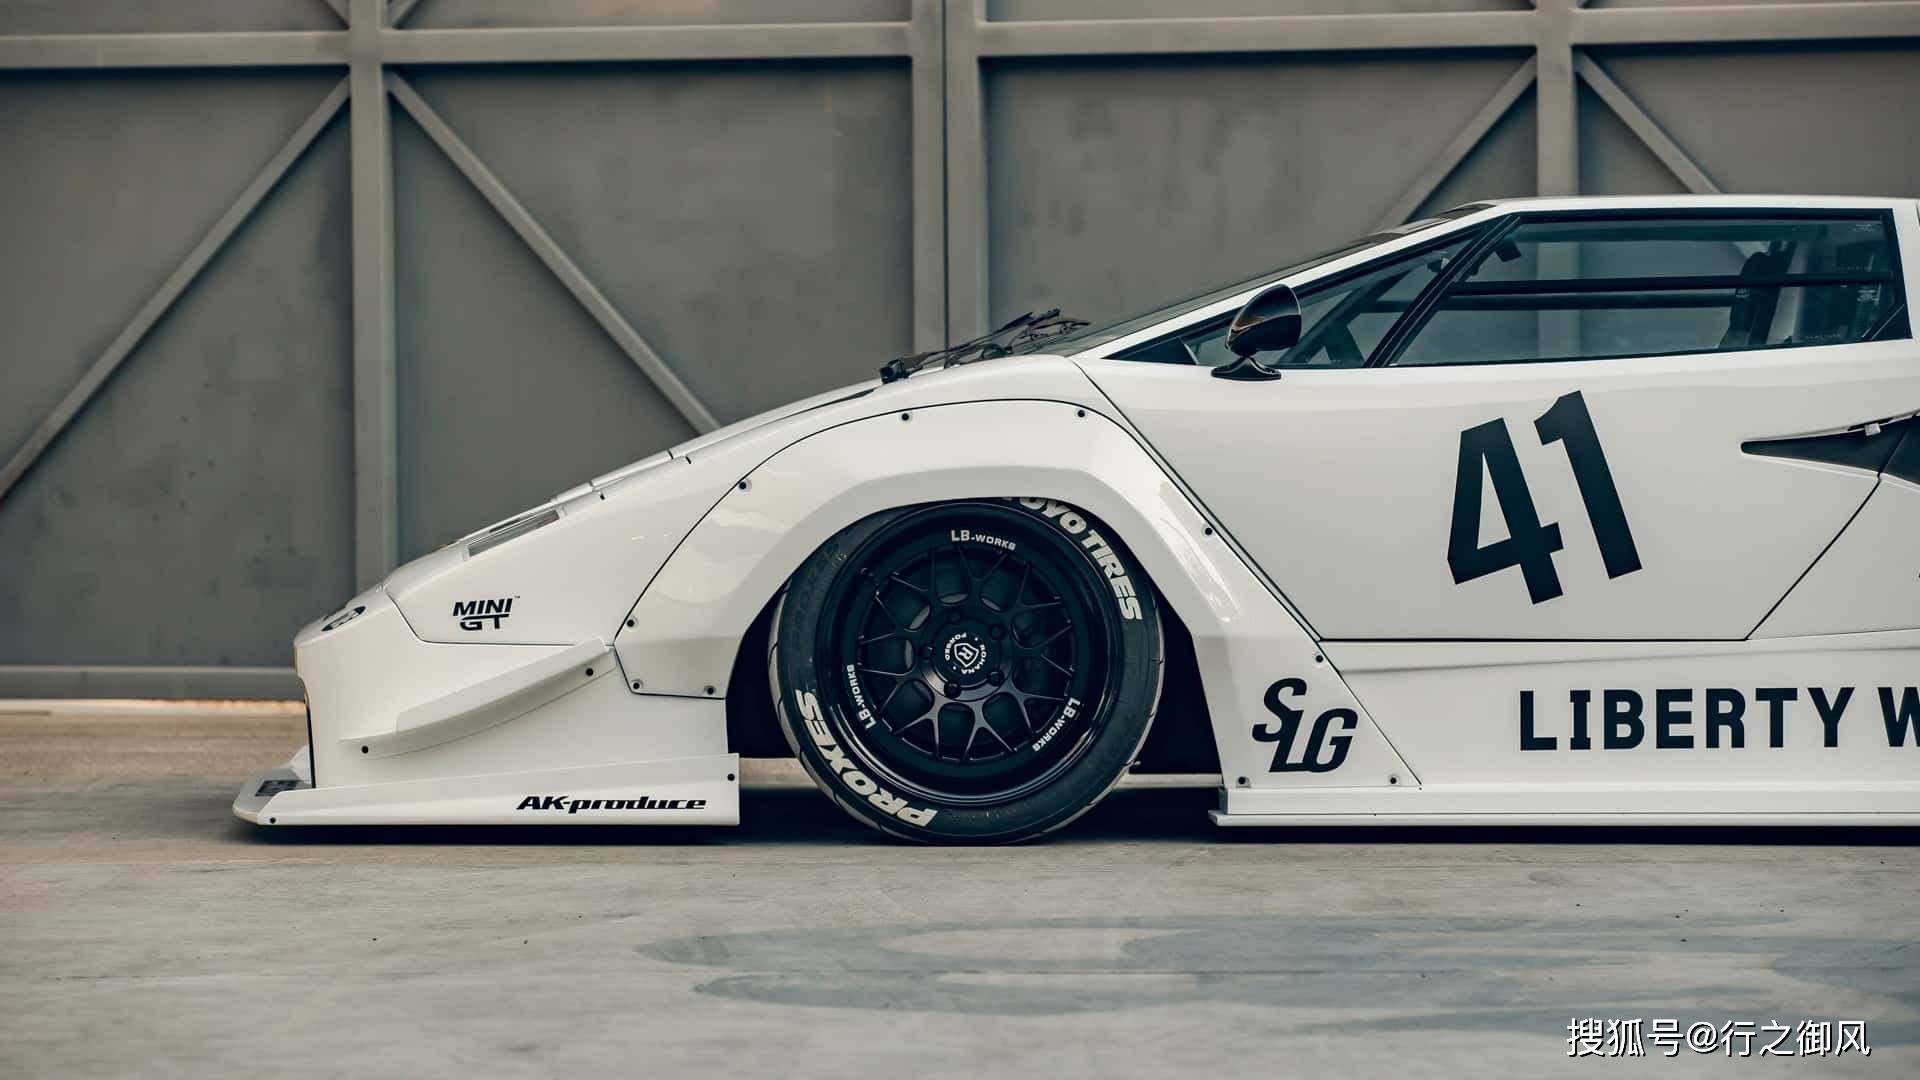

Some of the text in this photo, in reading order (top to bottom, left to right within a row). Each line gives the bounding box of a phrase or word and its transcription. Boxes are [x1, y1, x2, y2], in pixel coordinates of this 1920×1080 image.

[1447, 390, 1642, 604] 41
[453, 598, 513, 616] MINI
[1081, 529, 1143, 621] TIRES
[460, 614, 509, 631] GT
[795, 689, 938, 827] PROXES
[1252, 677, 1358, 773] SLG
[1520, 687, 1855, 751] LIBERTY
[516, 796, 707, 814] AK-produce
